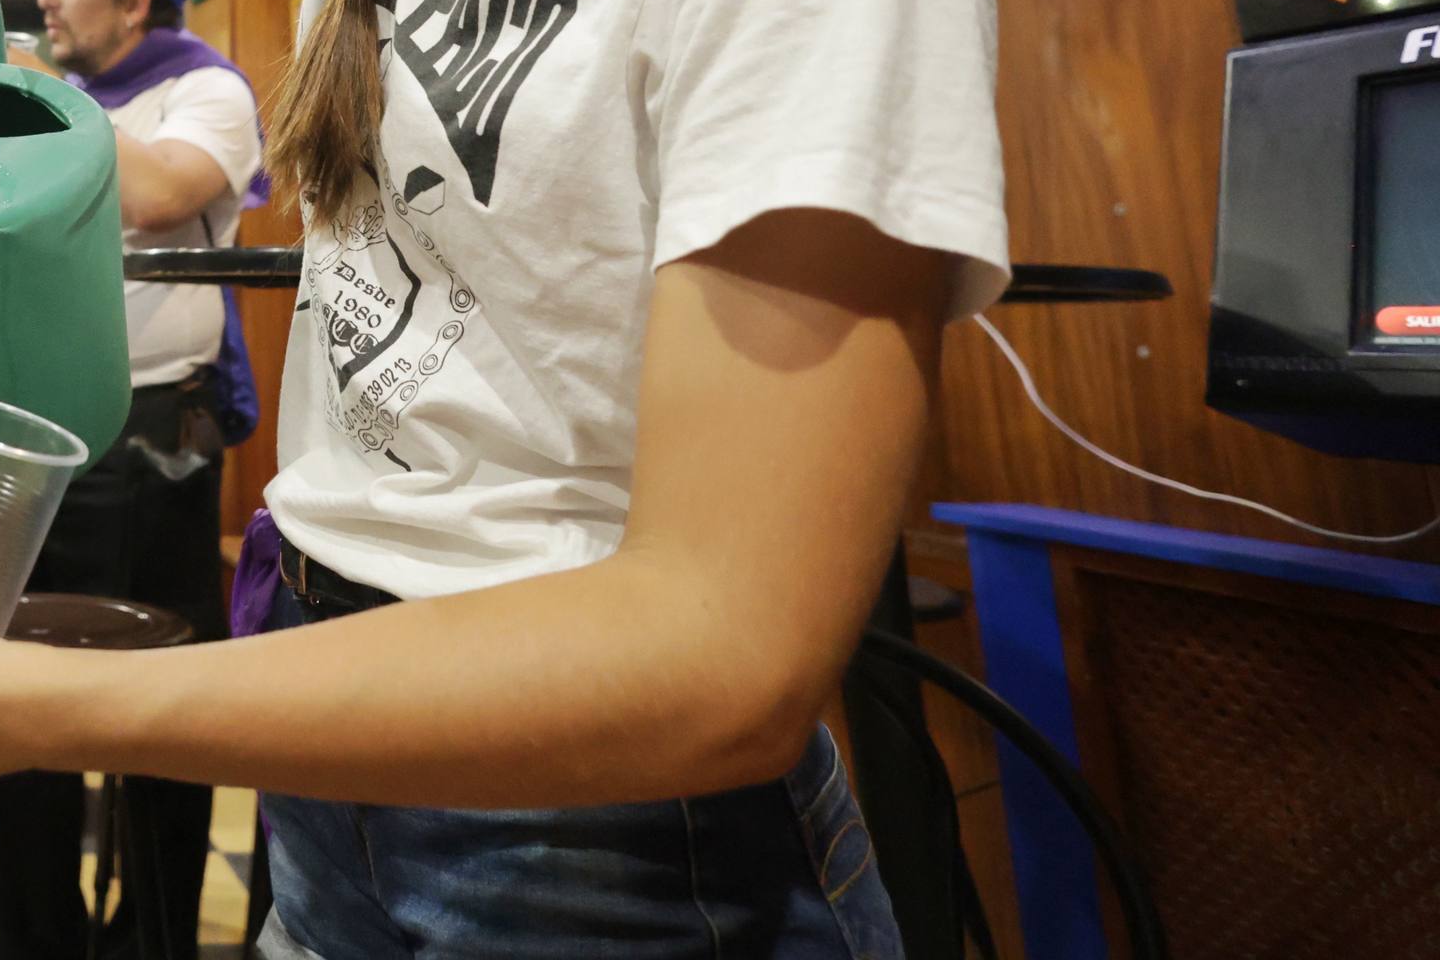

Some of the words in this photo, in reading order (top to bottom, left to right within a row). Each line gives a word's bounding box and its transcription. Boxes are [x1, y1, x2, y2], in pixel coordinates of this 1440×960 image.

[333, 260, 396, 309] Desde
[334, 290, 382, 329] 1980
[367, 379, 383, 402] 39
[380, 367, 398, 388] 02
[394, 357, 412, 374] 13
